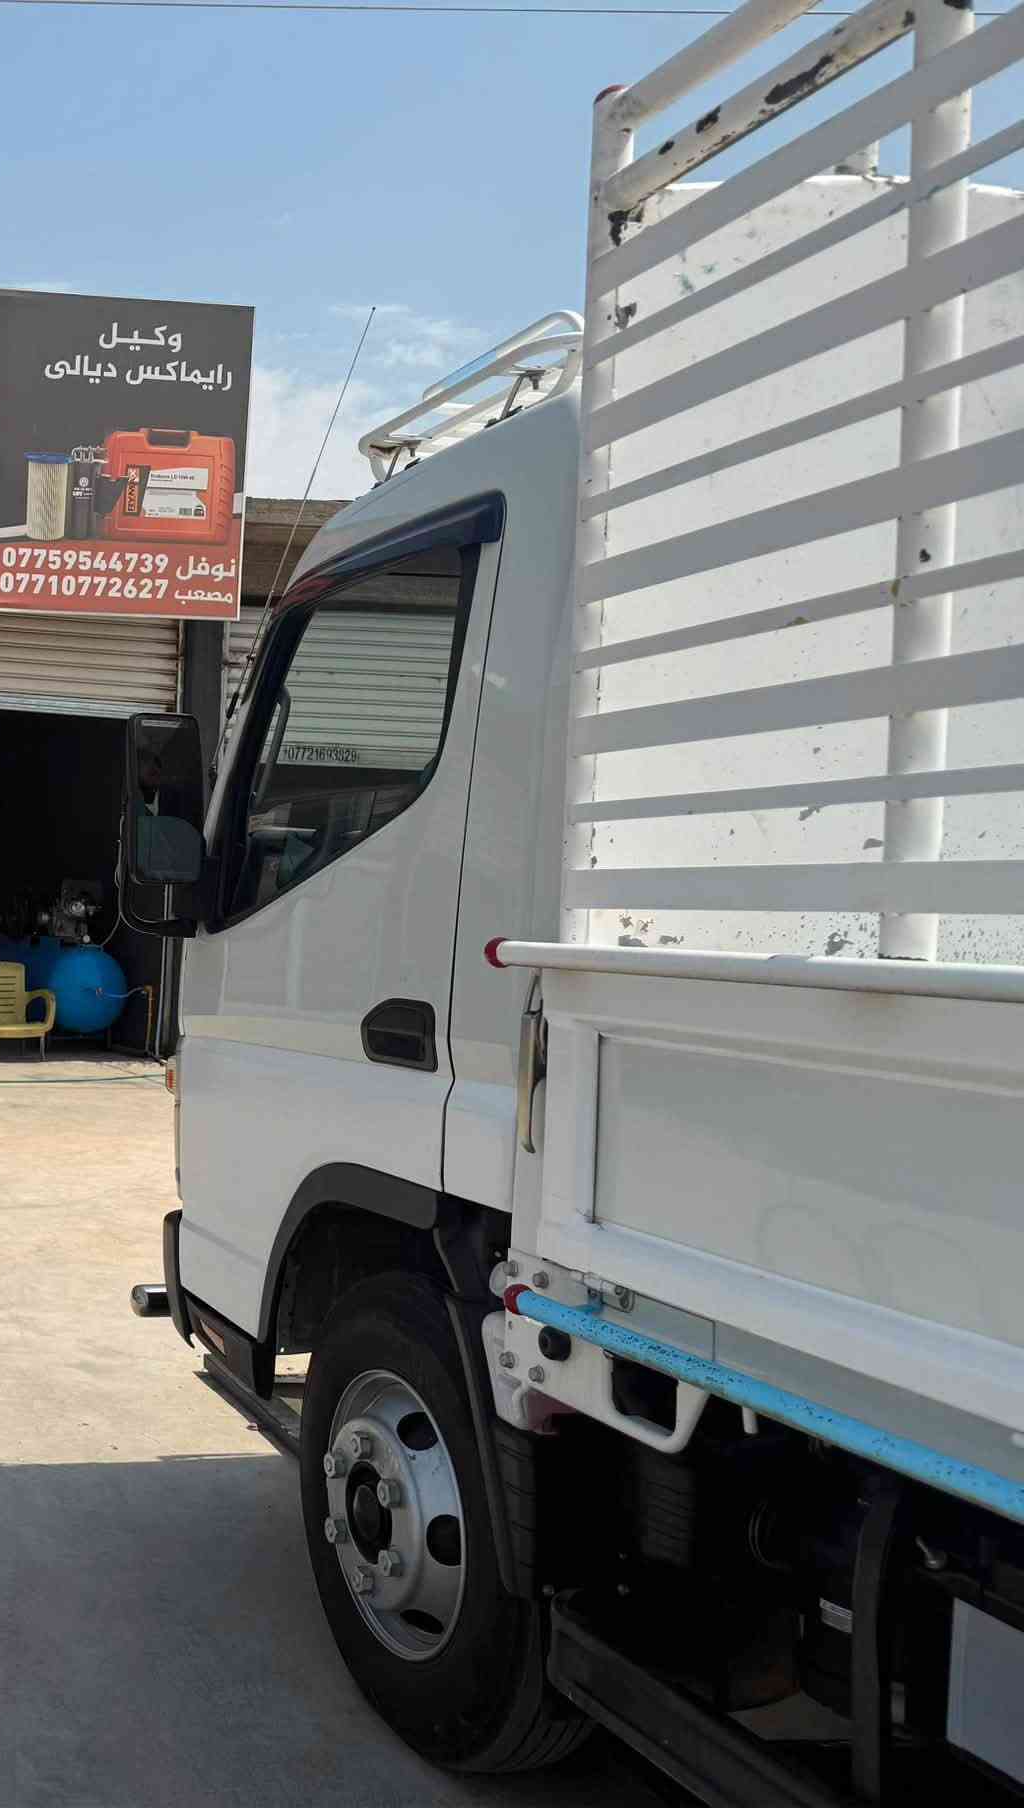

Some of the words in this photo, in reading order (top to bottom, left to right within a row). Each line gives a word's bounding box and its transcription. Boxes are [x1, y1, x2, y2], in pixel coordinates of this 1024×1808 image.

[98, 321, 182, 353] وكيل
[125, 360, 232, 391] رايماكس
[2, 546, 169, 573] 07759544739
[176, 554, 236, 582] نوفل
[0, 572, 169, 599] 07710772627
[173, 586, 233, 605] مصعب
